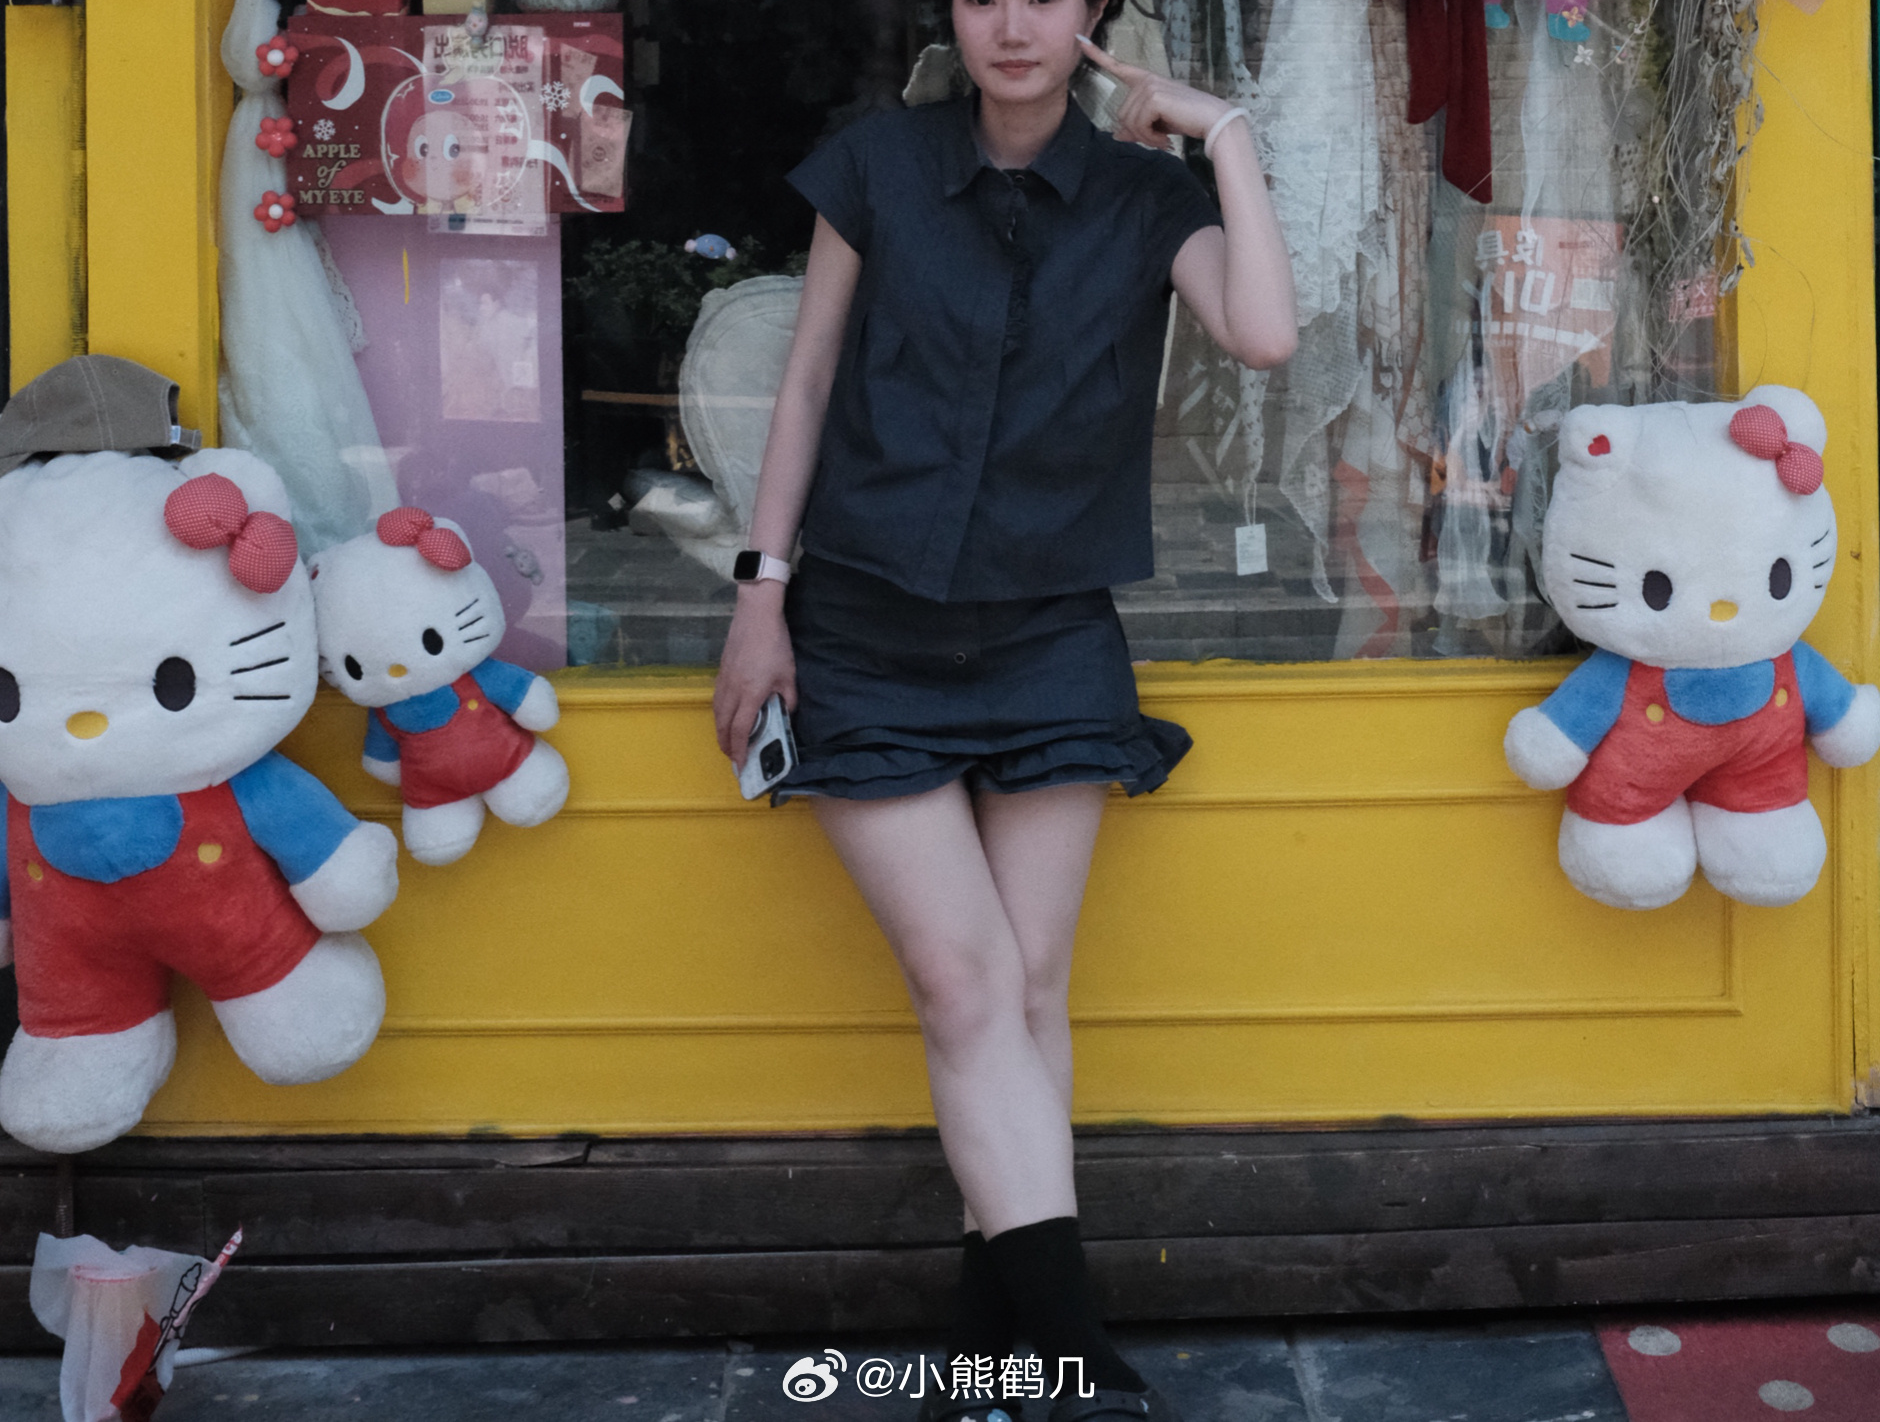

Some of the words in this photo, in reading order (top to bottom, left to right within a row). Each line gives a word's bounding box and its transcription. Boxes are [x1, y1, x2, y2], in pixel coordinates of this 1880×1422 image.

[302, 143, 361, 158] APPLE
[317, 159, 347, 188] of
[299, 189, 326, 205] MY
[328, 189, 366, 205] EYE
